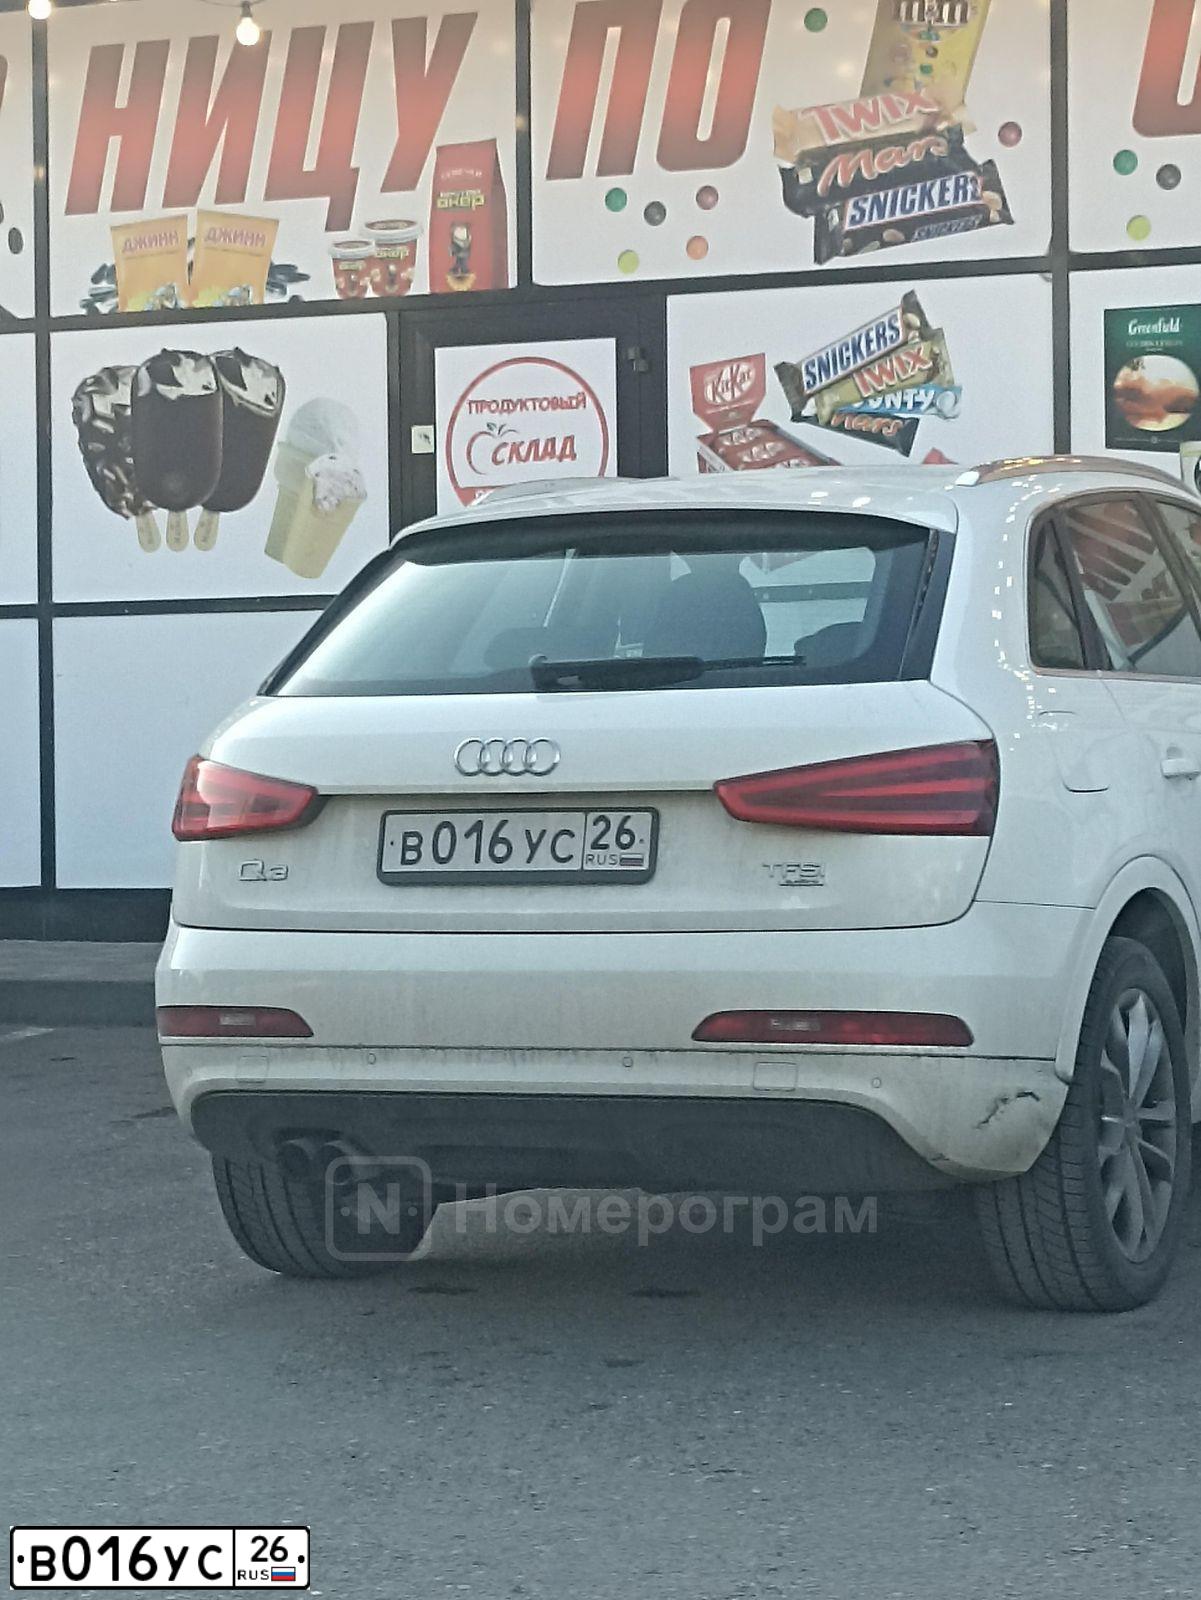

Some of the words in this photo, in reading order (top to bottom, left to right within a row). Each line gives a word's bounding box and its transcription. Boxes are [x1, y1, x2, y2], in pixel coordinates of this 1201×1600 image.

[64, 12, 478, 231] НИЦУ
[545, 0, 772, 181] ПО
[803, 312, 902, 391] SNICKERS
[466, 391, 587, 416] ПРОДУКТОВЫЙ
[491, 434, 577, 466] СКЛАД
[401, 819, 576, 866] В016УС
[590, 814, 636, 850] 26
[585, 853, 618, 867] RUS
